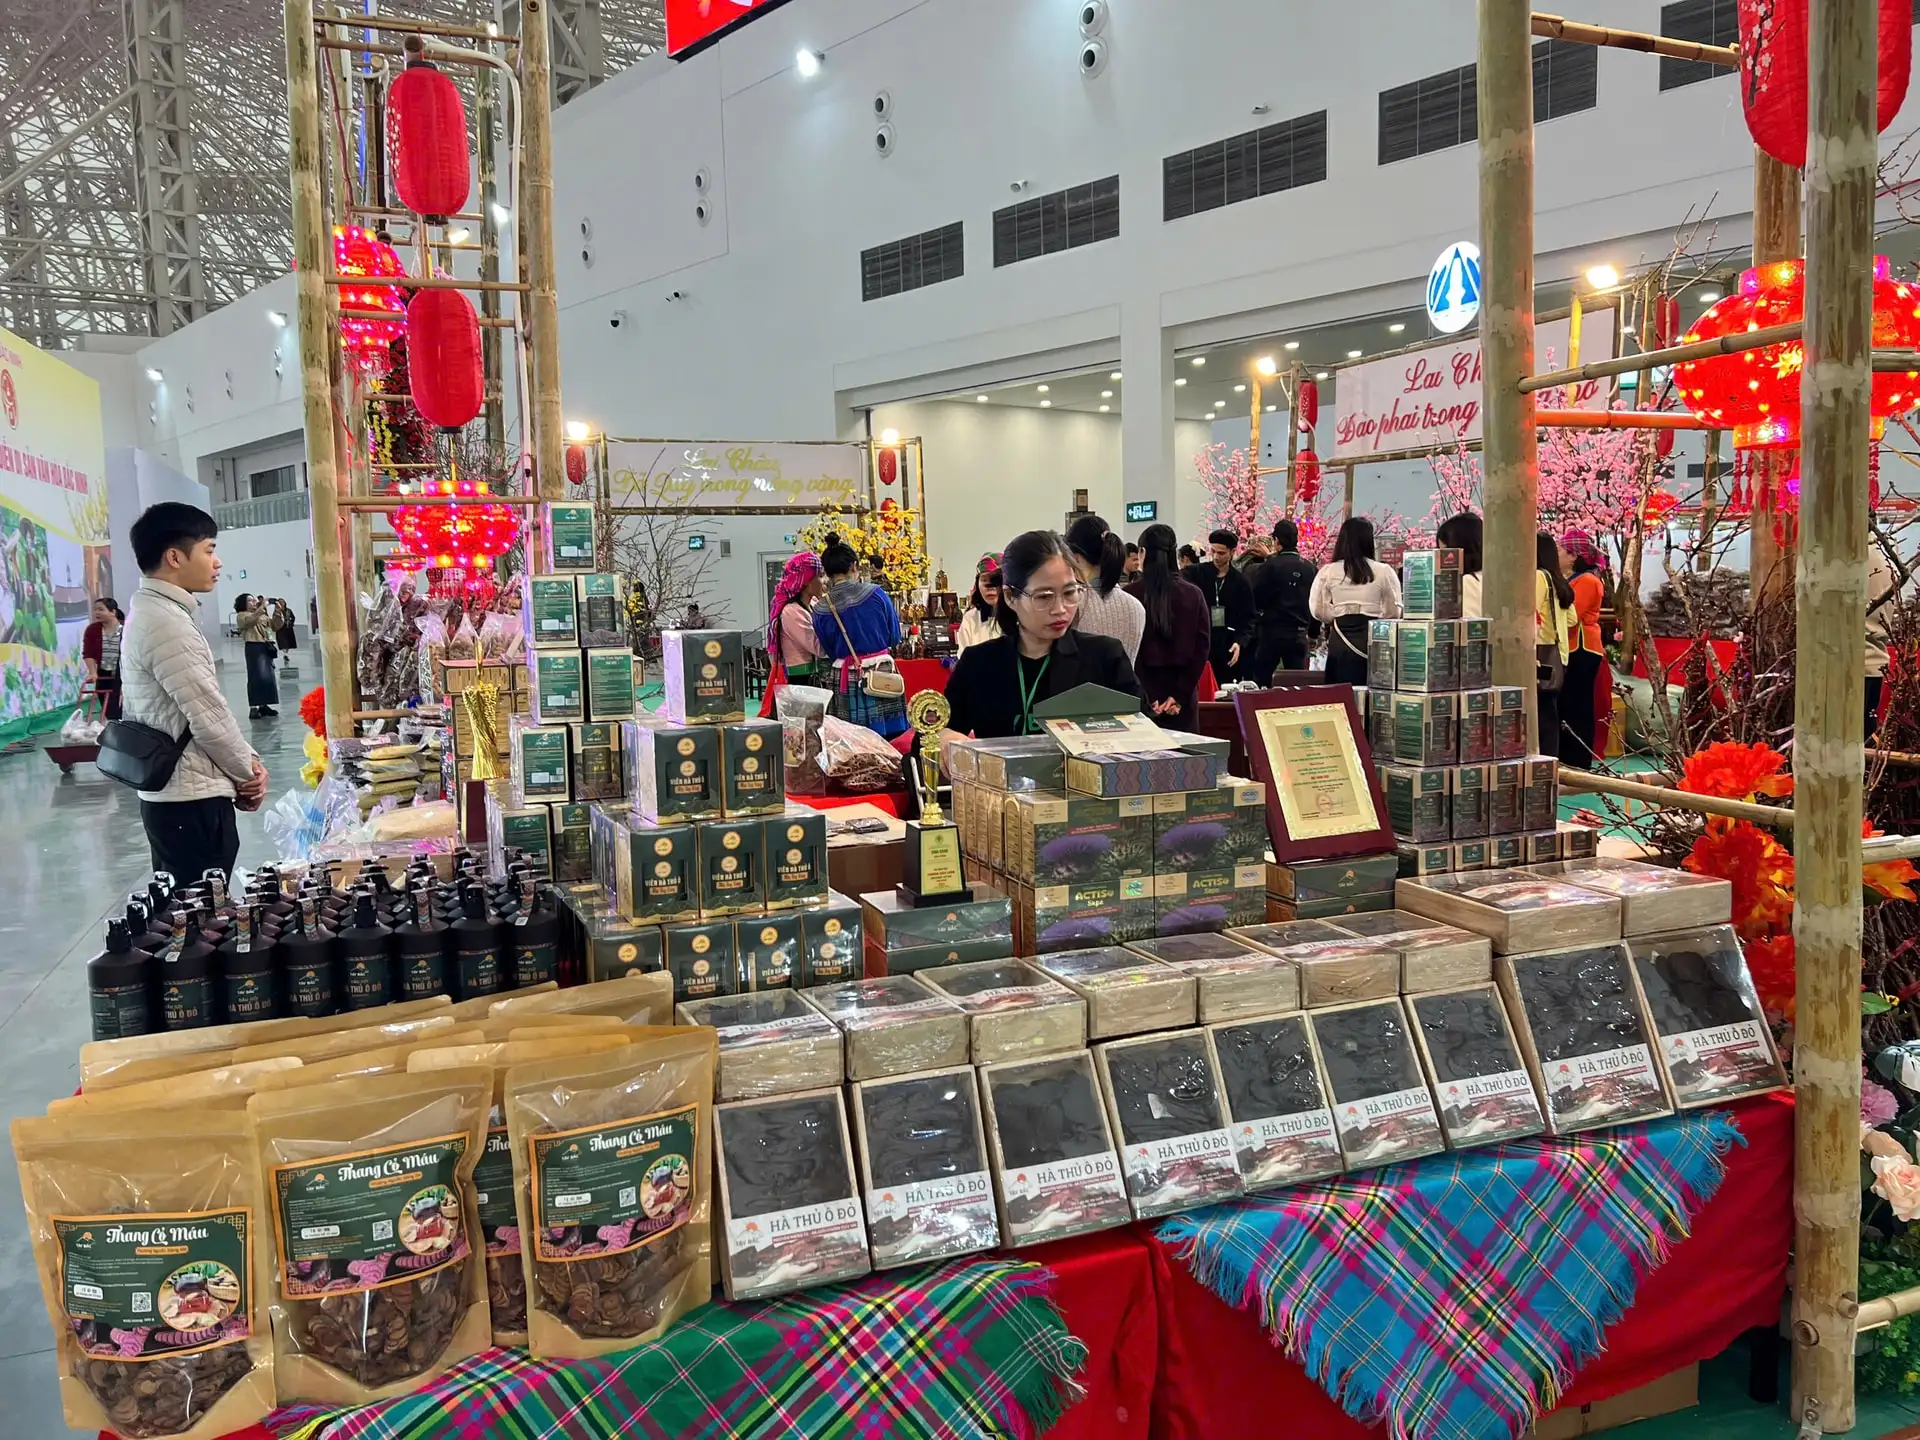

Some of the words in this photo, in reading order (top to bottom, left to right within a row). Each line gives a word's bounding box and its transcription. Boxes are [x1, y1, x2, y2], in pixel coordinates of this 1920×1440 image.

[1403, 359, 1444, 393] Lai
[1337, 412, 1377, 445] Đào
[1374, 398, 1420, 449] phai
[1423, 402, 1478, 436] trong
[1692, 1033, 1708, 1048] HÀ
[1708, 1028, 1731, 1044] THỦ
[1733, 1027, 1740, 1040] Ô
[1741, 1024, 1755, 1038] ĐỎ
[1578, 1059, 1597, 1074] HÀ
[1597, 1053, 1619, 1069] THỦ
[1621, 1051, 1629, 1065] Ô
[1631, 1048, 1644, 1063] ĐỎ
[1466, 1081, 1482, 1095] HÀ
[1482, 1077, 1503, 1092] THỦ
[1505, 1076, 1511, 1088] Ô
[1513, 1073, 1527, 1087] ĐỎ
[1365, 1101, 1382, 1115] HÀ
[1381, 1095, 1403, 1110] THỦ
[1404, 1094, 1412, 1106] Ô
[1413, 1090, 1428, 1104] ĐỎ
[1261, 1121, 1279, 1136] HÀ
[1280, 1116, 1302, 1133] THỦ
[1304, 1114, 1312, 1128] Ô
[1313, 1112, 1329, 1127] ĐỎ
[589, 1134, 626, 1151] Thang
[644, 1124, 672, 1140] Máu
[1157, 1143, 1175, 1158] HÀ
[1176, 1137, 1200, 1154] THỦ
[1203, 1137, 1210, 1150] Ô
[1212, 1132, 1228, 1148] ĐỎ
[338, 1163, 380, 1182] Thang
[402, 1153, 439, 1169] Máu
[1037, 1168, 1056, 1184] HÀ
[1058, 1162, 1082, 1180] THỦ
[1085, 1161, 1093, 1174] Ô
[1095, 1156, 1113, 1172] ĐỎ
[957, 1180, 965, 1194] Ô
[968, 1175, 986, 1192] ĐỎ
[770, 1216, 791, 1232] HÀ
[793, 1208, 821, 1229] THỦ
[825, 1207, 834, 1222] Ô
[838, 1202, 857, 1219] ĐỎ
[106, 1225, 149, 1246] Thang
[169, 1226, 209, 1242] Máu
